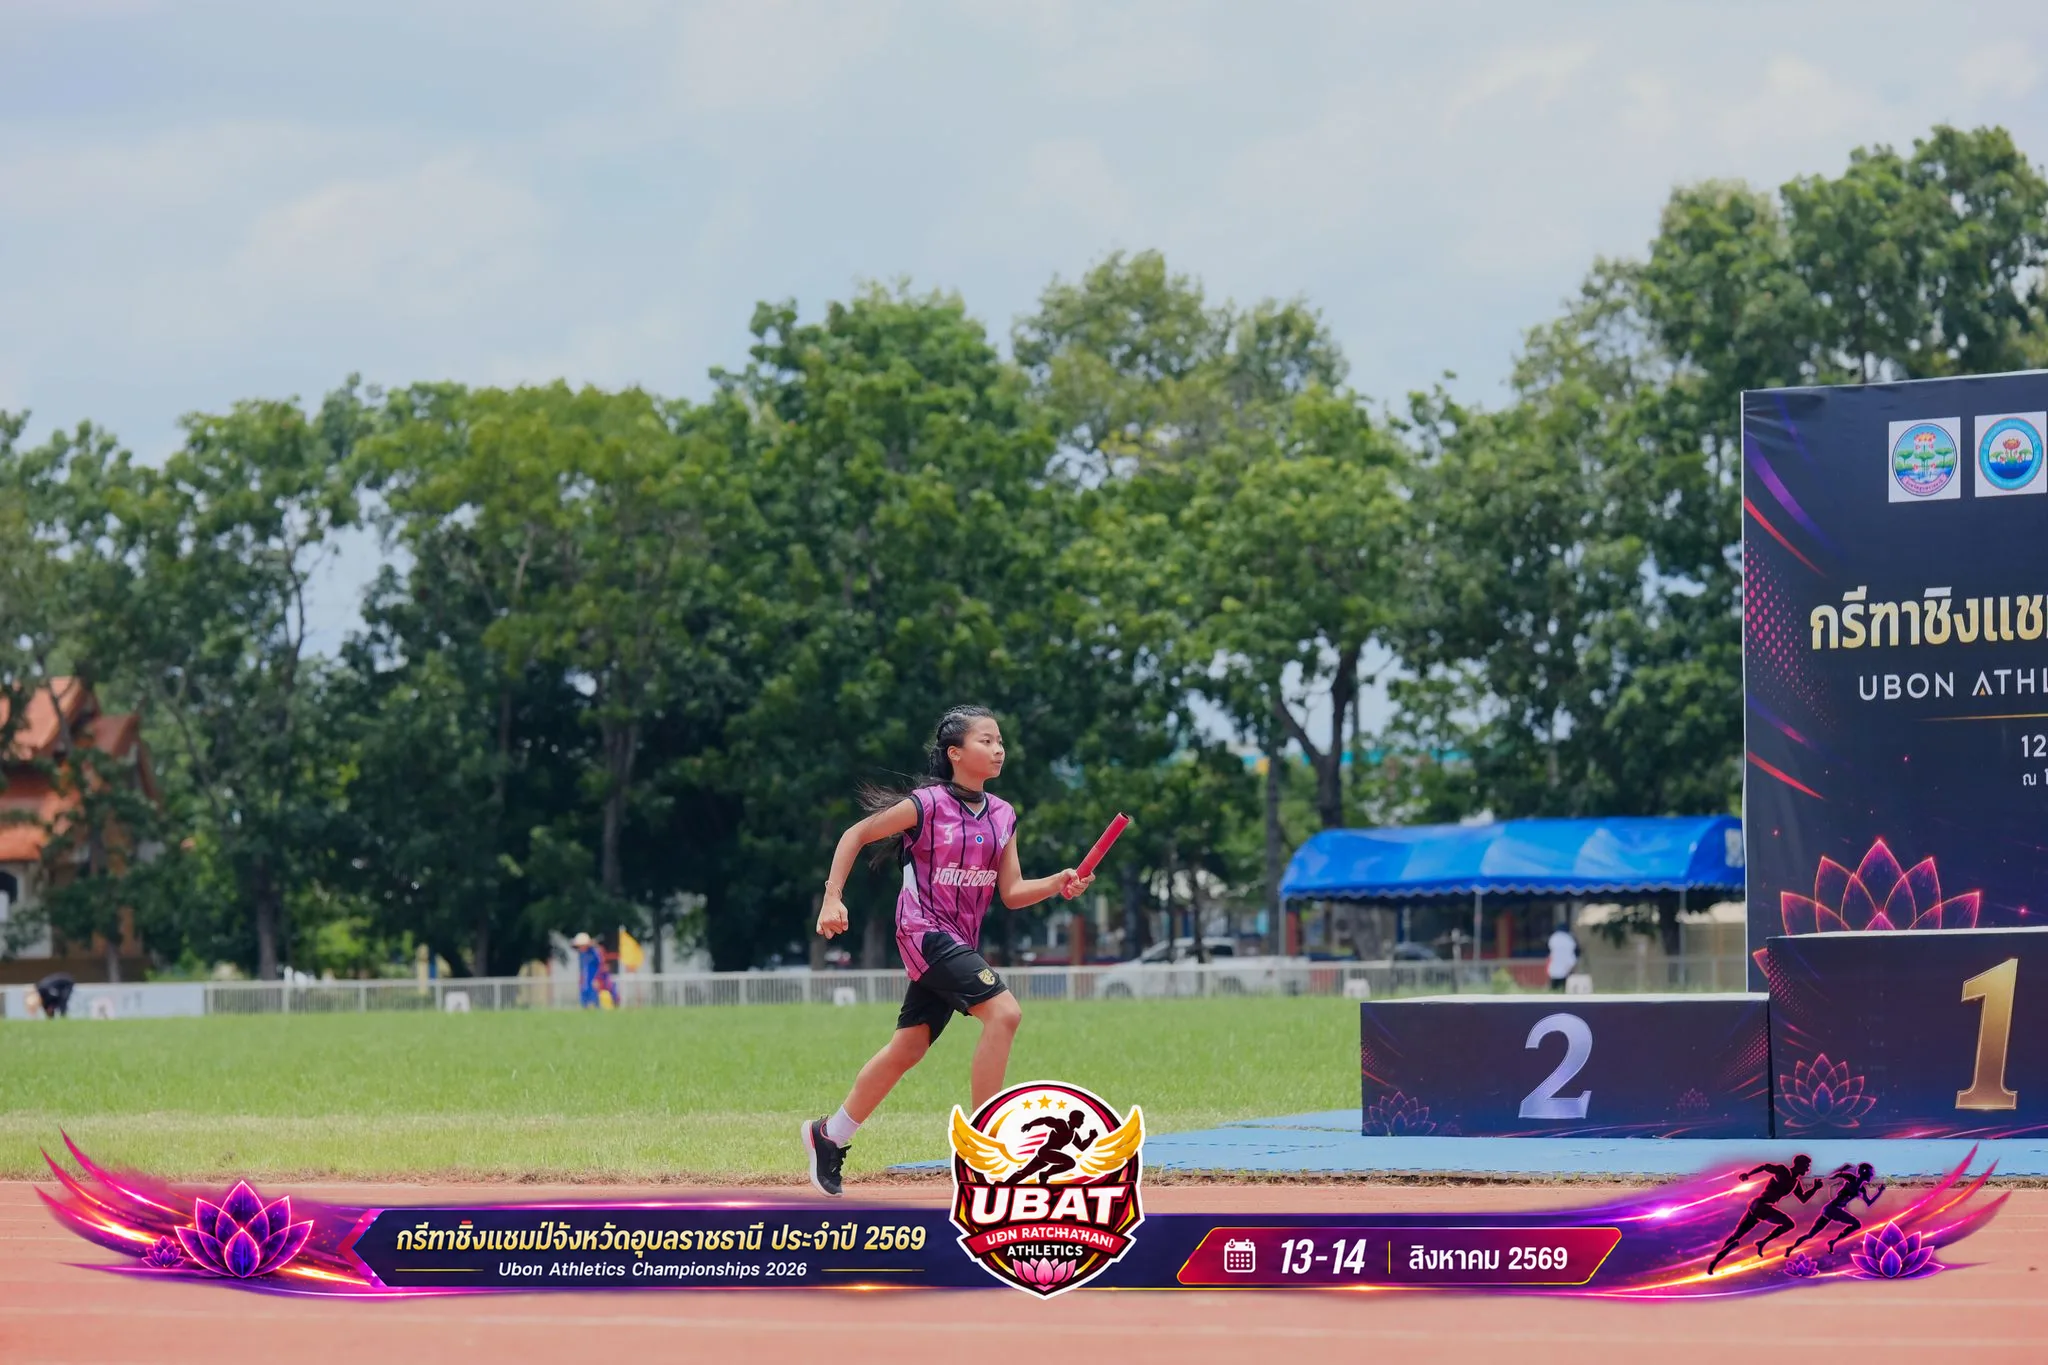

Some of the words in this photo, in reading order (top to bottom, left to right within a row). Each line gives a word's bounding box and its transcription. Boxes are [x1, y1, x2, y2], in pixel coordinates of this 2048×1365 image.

[1810, 586, 2048, 649] กรีฑาชิงแช
[1859, 671, 1954, 700] UBON
[2021, 734, 2047, 758] 12
[2022, 773, 2037, 786] ณ
[1955, 957, 2019, 1111] 1
[1518, 1012, 1593, 1119] 2
